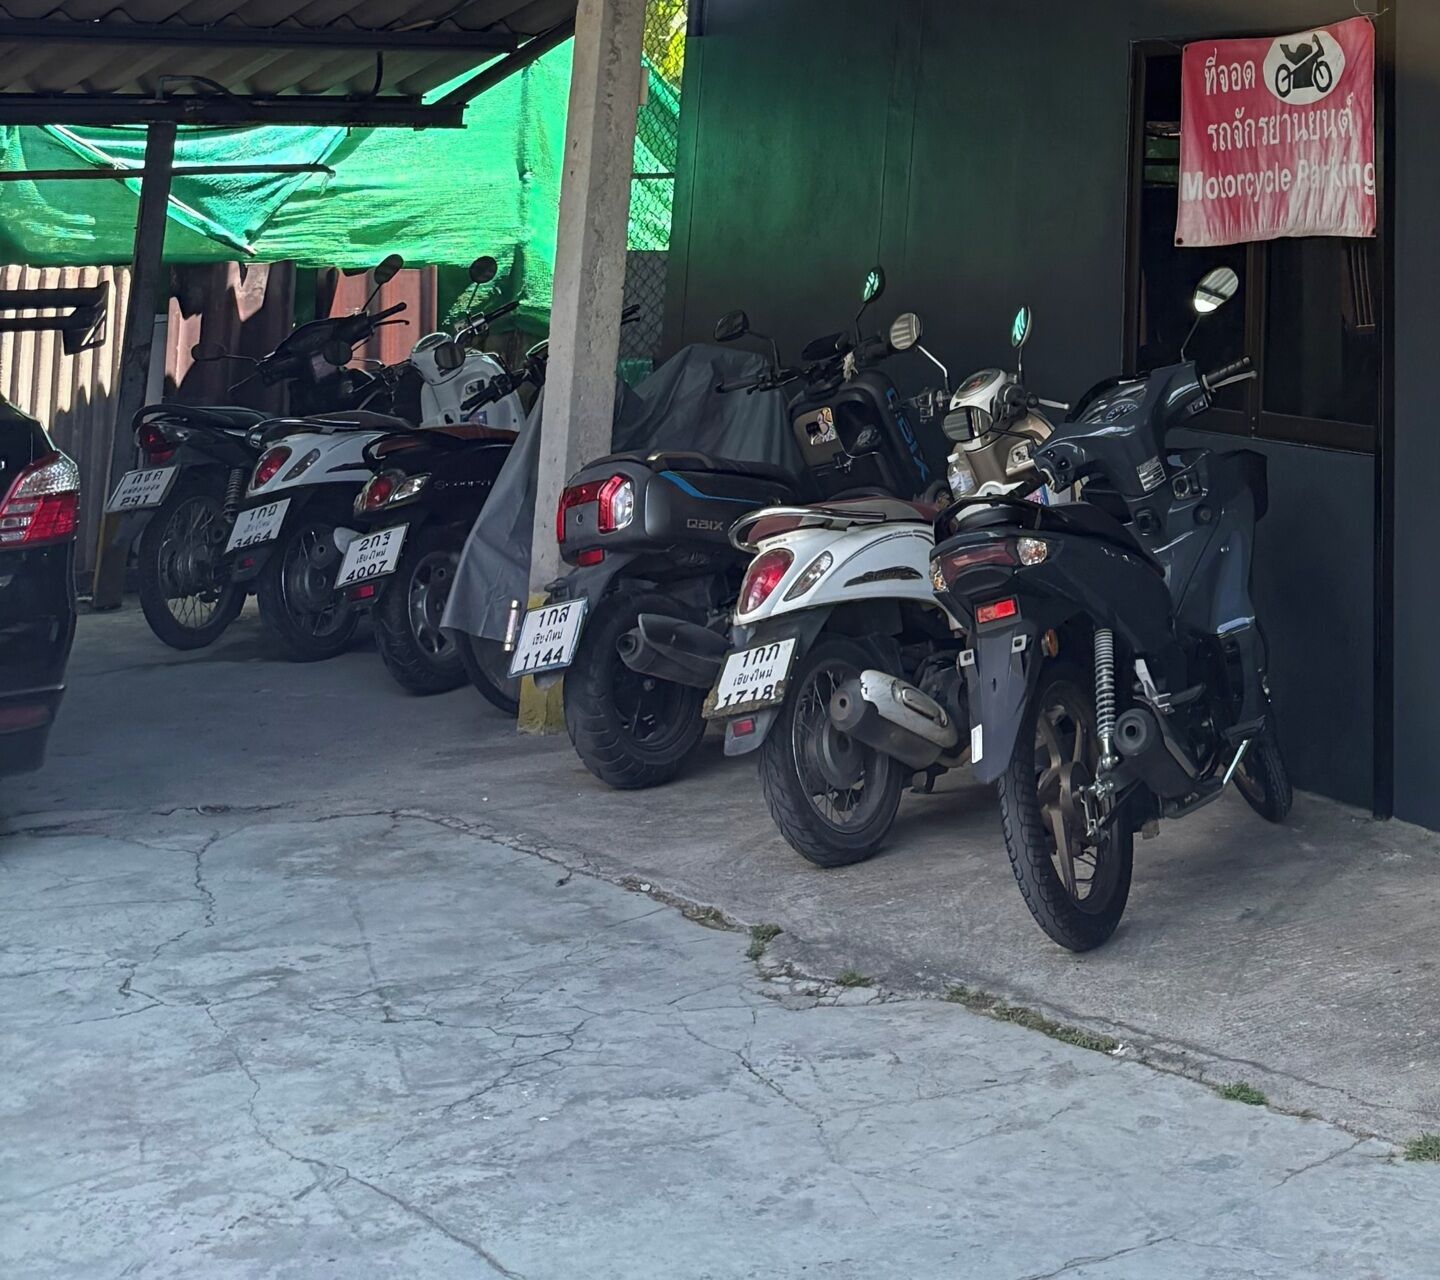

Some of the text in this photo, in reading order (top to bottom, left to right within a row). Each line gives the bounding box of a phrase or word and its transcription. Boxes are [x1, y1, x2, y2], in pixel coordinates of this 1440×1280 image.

[1204, 48, 1256, 96] ที่จอด
[1207, 92, 1355, 152] รถจักรยานยนต์
[1182, 156, 1376, 202] Motorcycle Parking
[346, 560, 388, 581] 4007
[523, 645, 564, 670] 1144
[733, 665, 773, 686] เชียงใหม่
[723, 684, 774, 706] 1718
